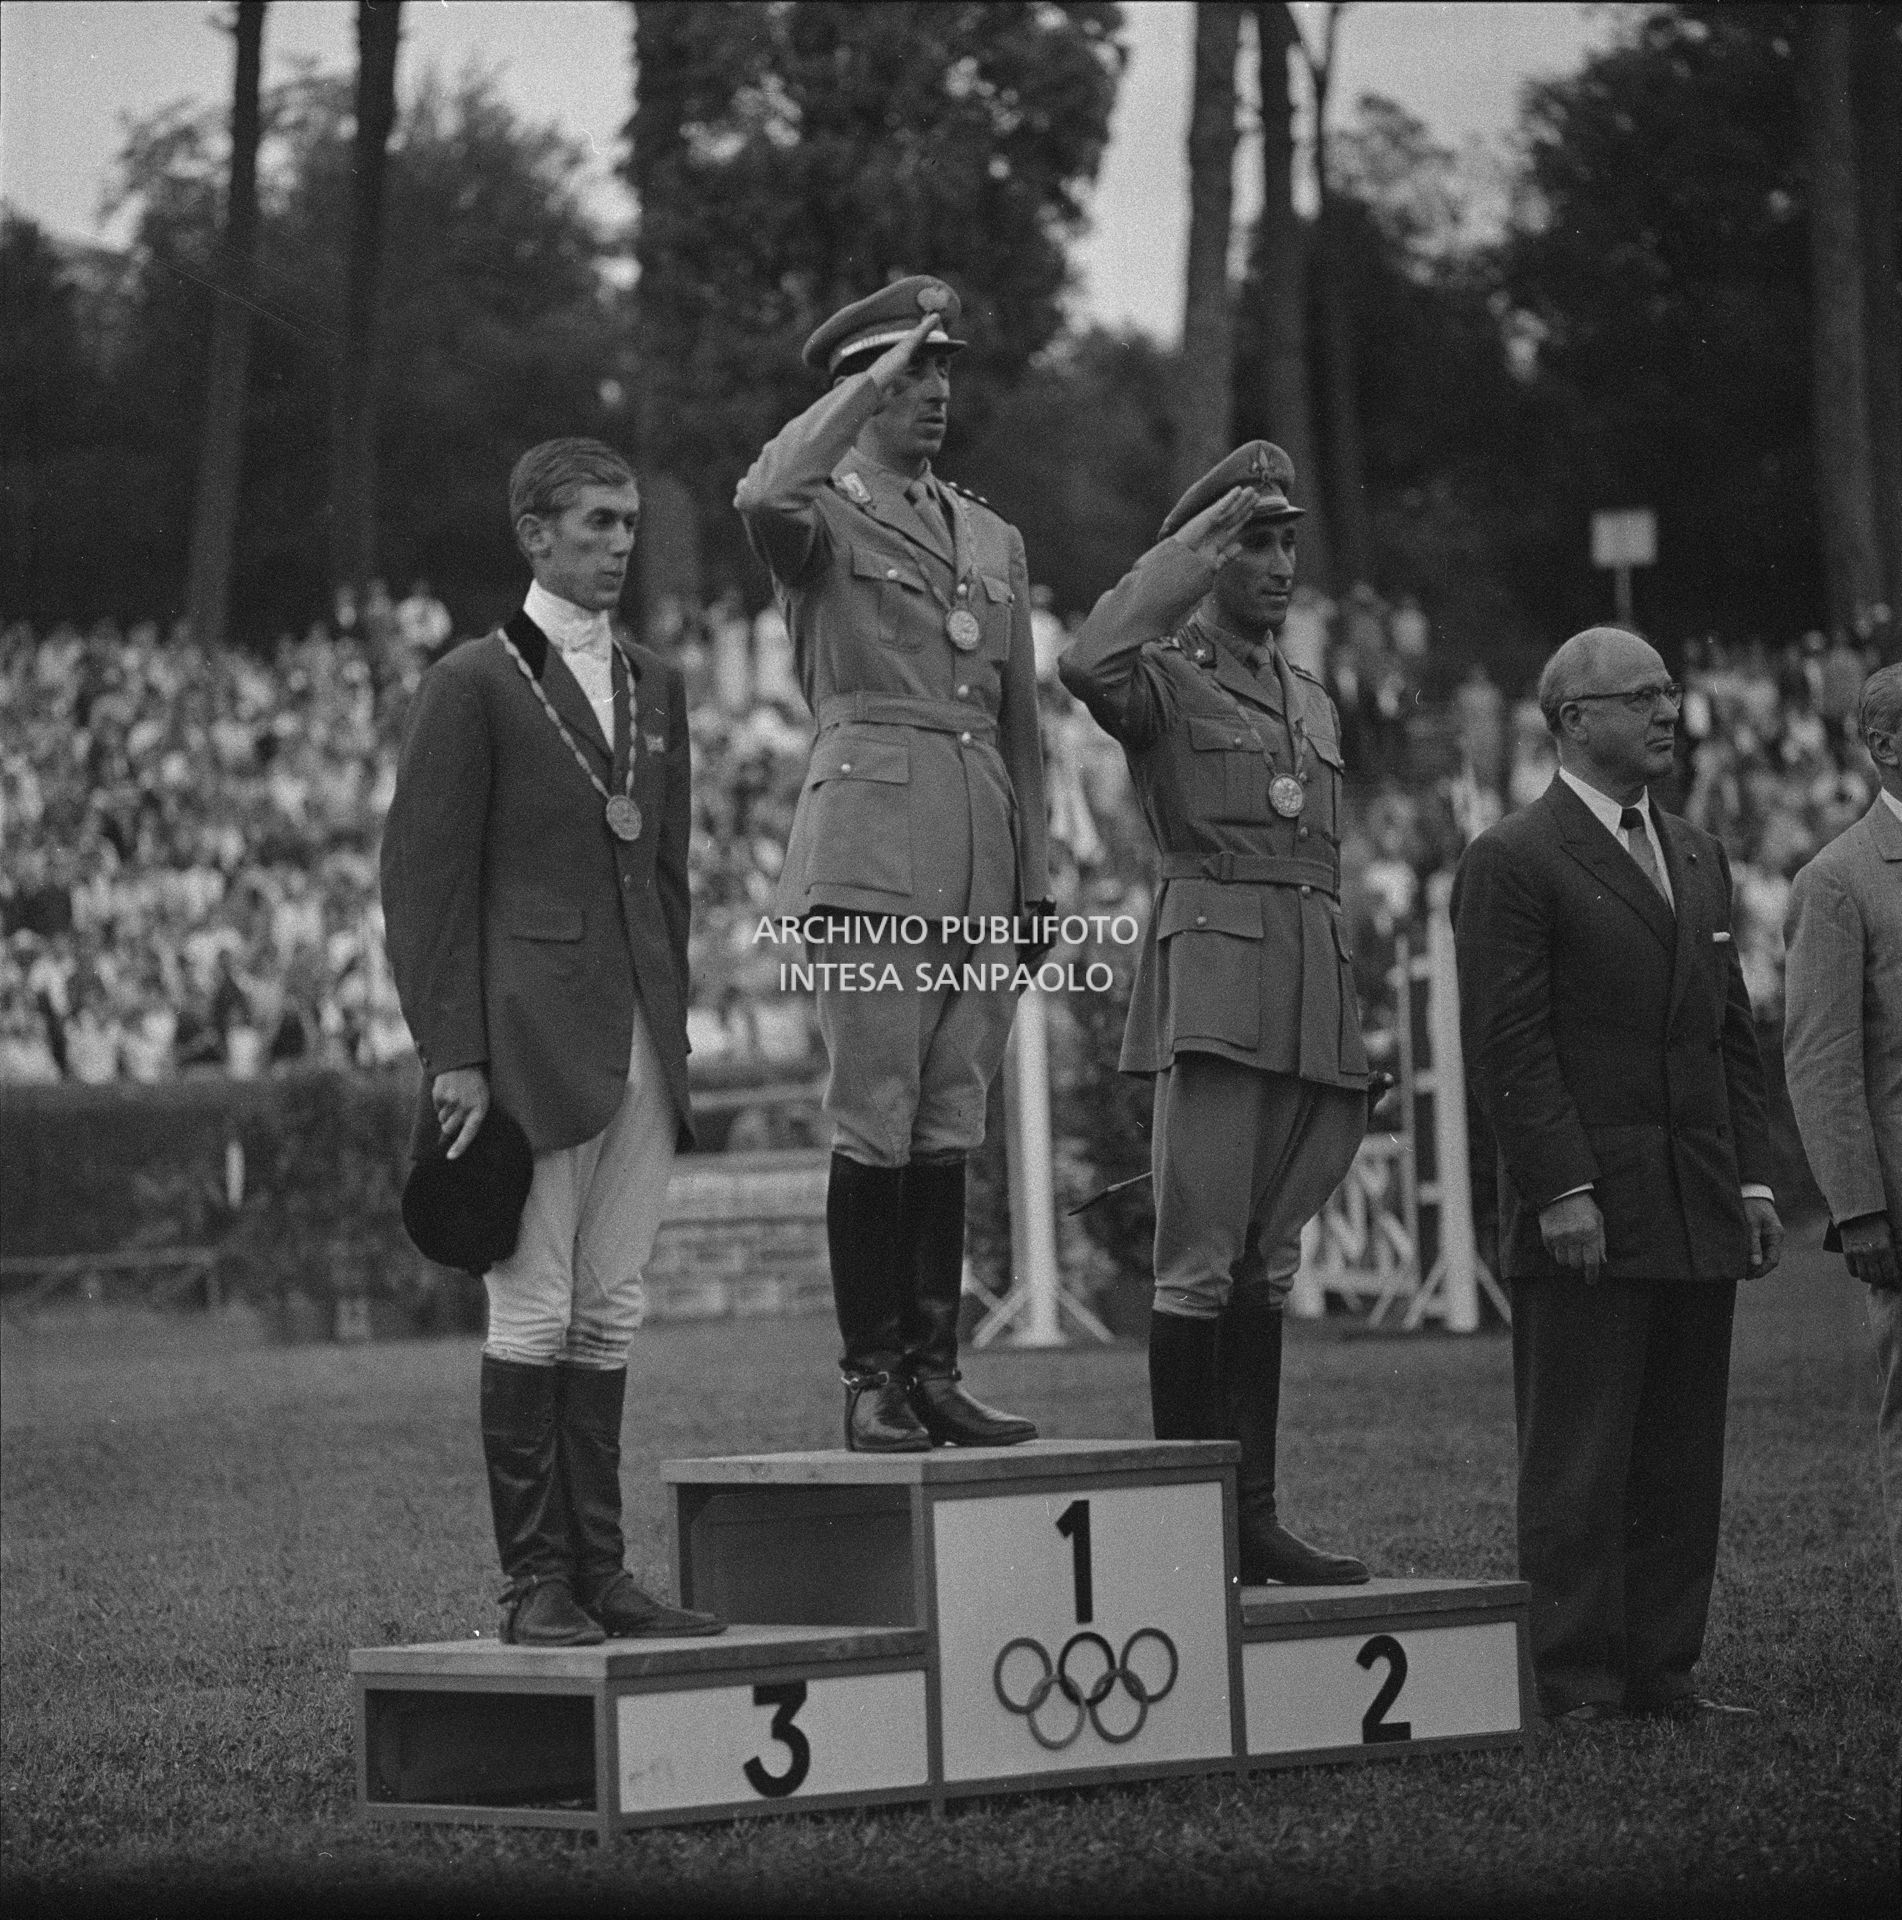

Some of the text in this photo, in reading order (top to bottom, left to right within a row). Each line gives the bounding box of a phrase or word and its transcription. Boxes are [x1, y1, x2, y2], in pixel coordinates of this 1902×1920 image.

[1055, 1499, 1094, 1624] 1
[743, 1681, 811, 1798] 3
[1355, 1634, 1412, 1744] 2
